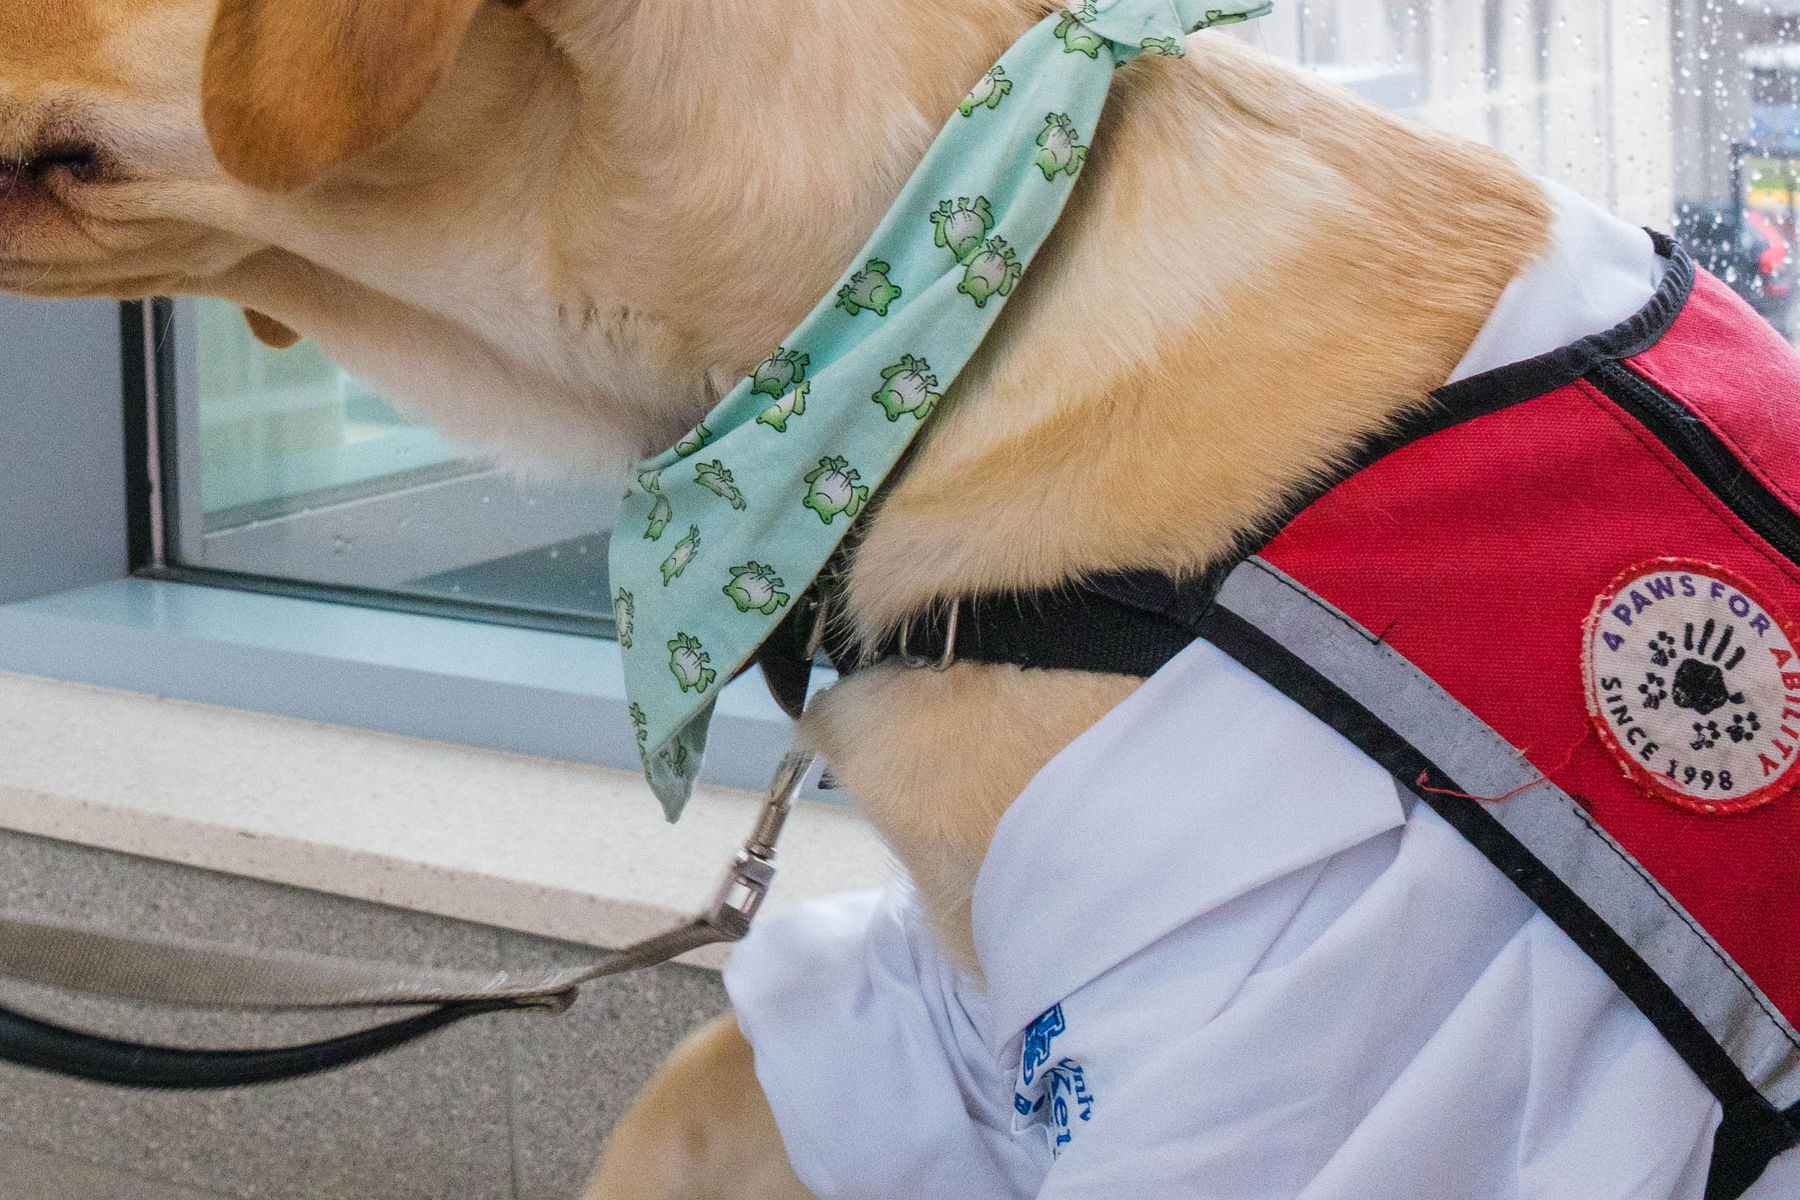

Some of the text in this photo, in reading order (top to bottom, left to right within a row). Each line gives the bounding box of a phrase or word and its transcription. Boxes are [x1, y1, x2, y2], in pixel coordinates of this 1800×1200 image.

[1601, 676, 1733, 791] SINCE 1998
[1602, 575, 1800, 777] 4 PAWS FOR ABILITY
